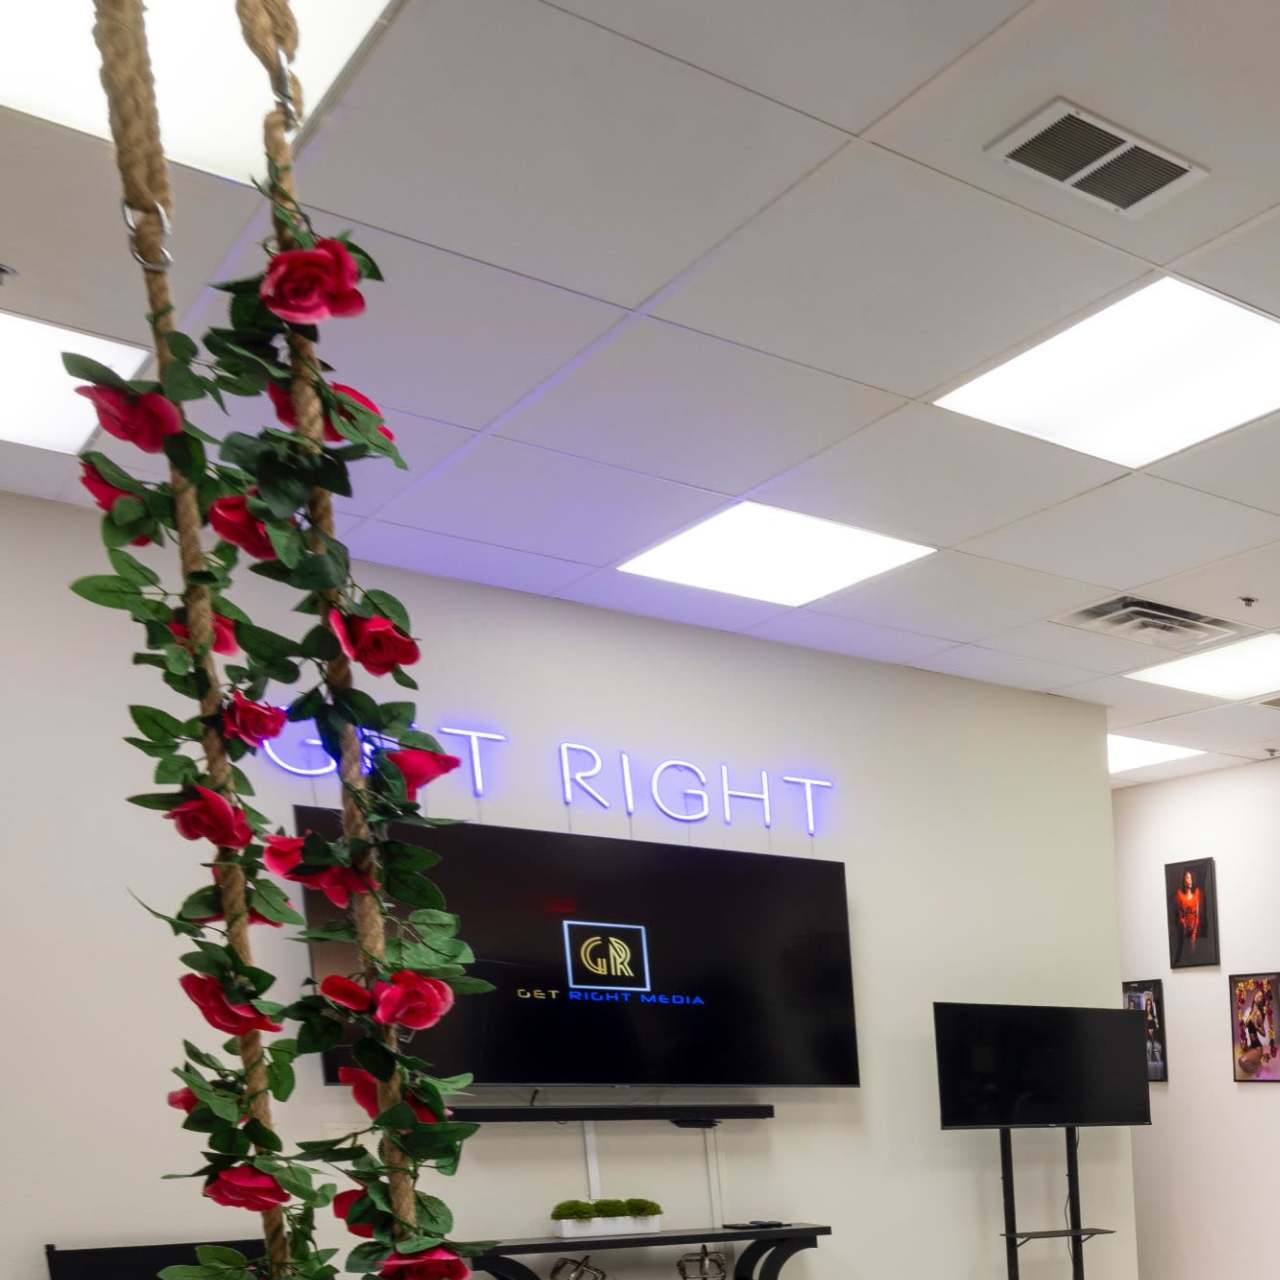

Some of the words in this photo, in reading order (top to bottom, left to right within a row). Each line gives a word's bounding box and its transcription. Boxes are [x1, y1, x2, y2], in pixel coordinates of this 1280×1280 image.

[559, 742, 833, 836] RIGHT
[580, 936, 635, 977] GR
[516, 988, 560, 999] GET
[568, 990, 631, 1002] RIGHT
[640, 993, 705, 1005] MEDIA
